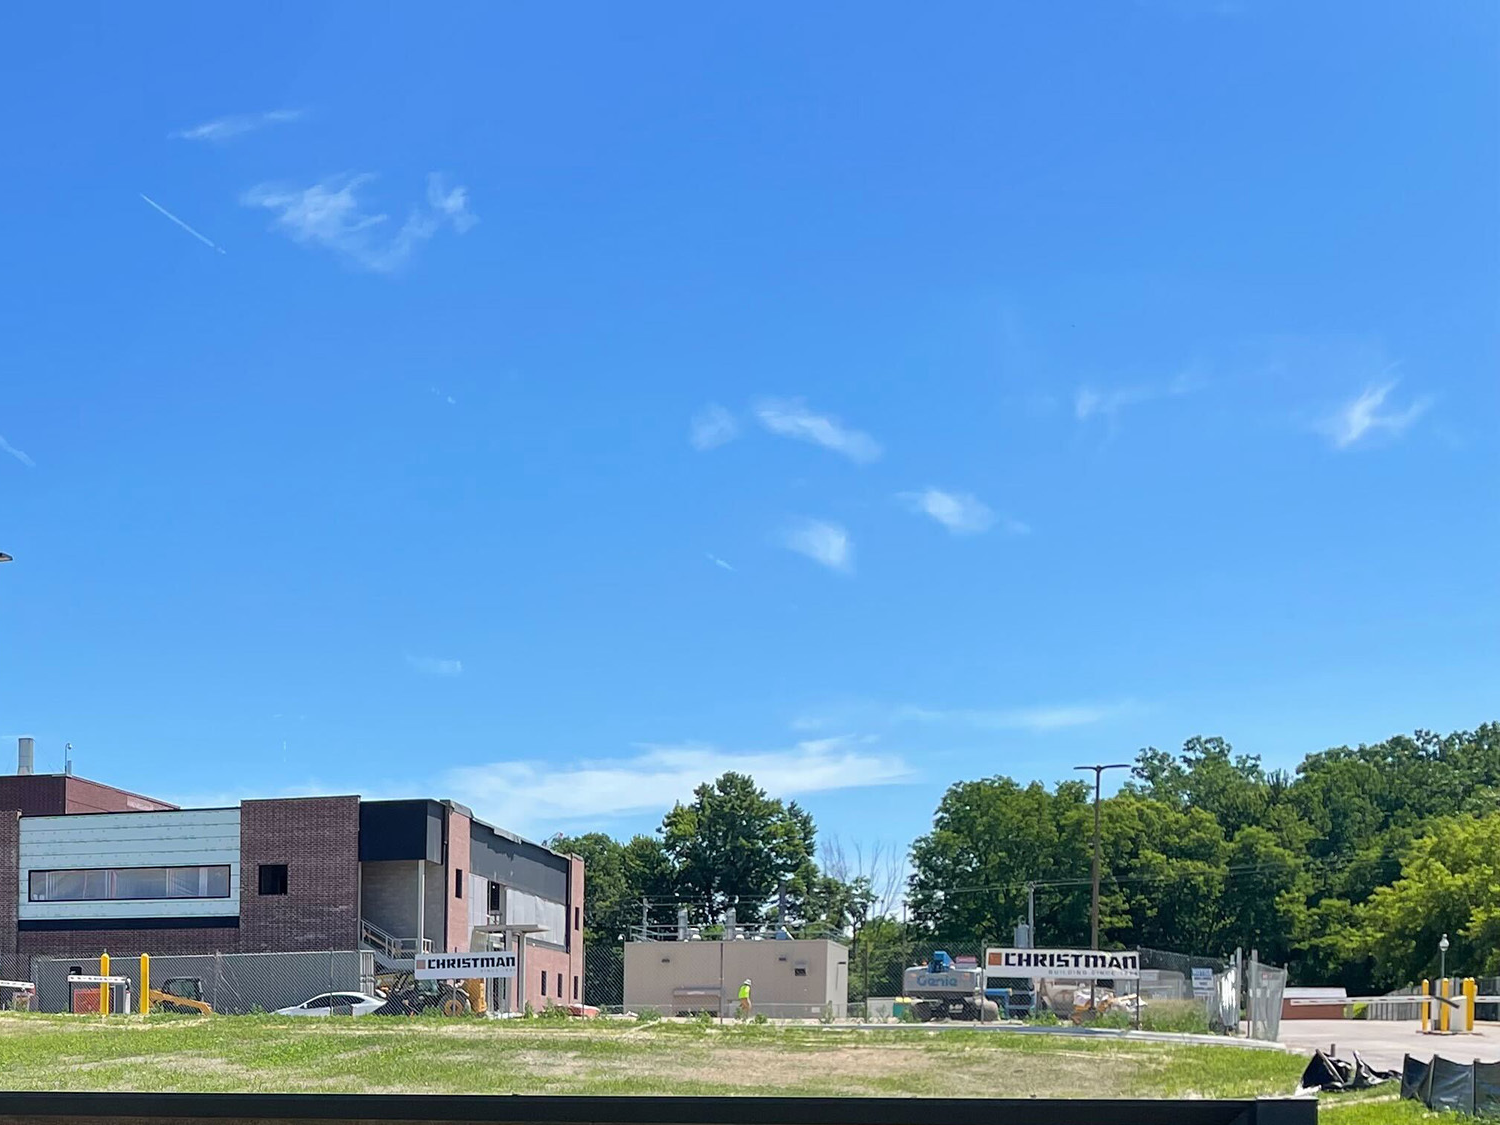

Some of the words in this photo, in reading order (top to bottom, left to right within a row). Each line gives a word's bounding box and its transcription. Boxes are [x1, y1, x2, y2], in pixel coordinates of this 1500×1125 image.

[428, 957, 515, 969] CHRISTMAN
[1004, 952, 1138, 970] CHRISTMAN
[916, 975, 958, 987] Genie
